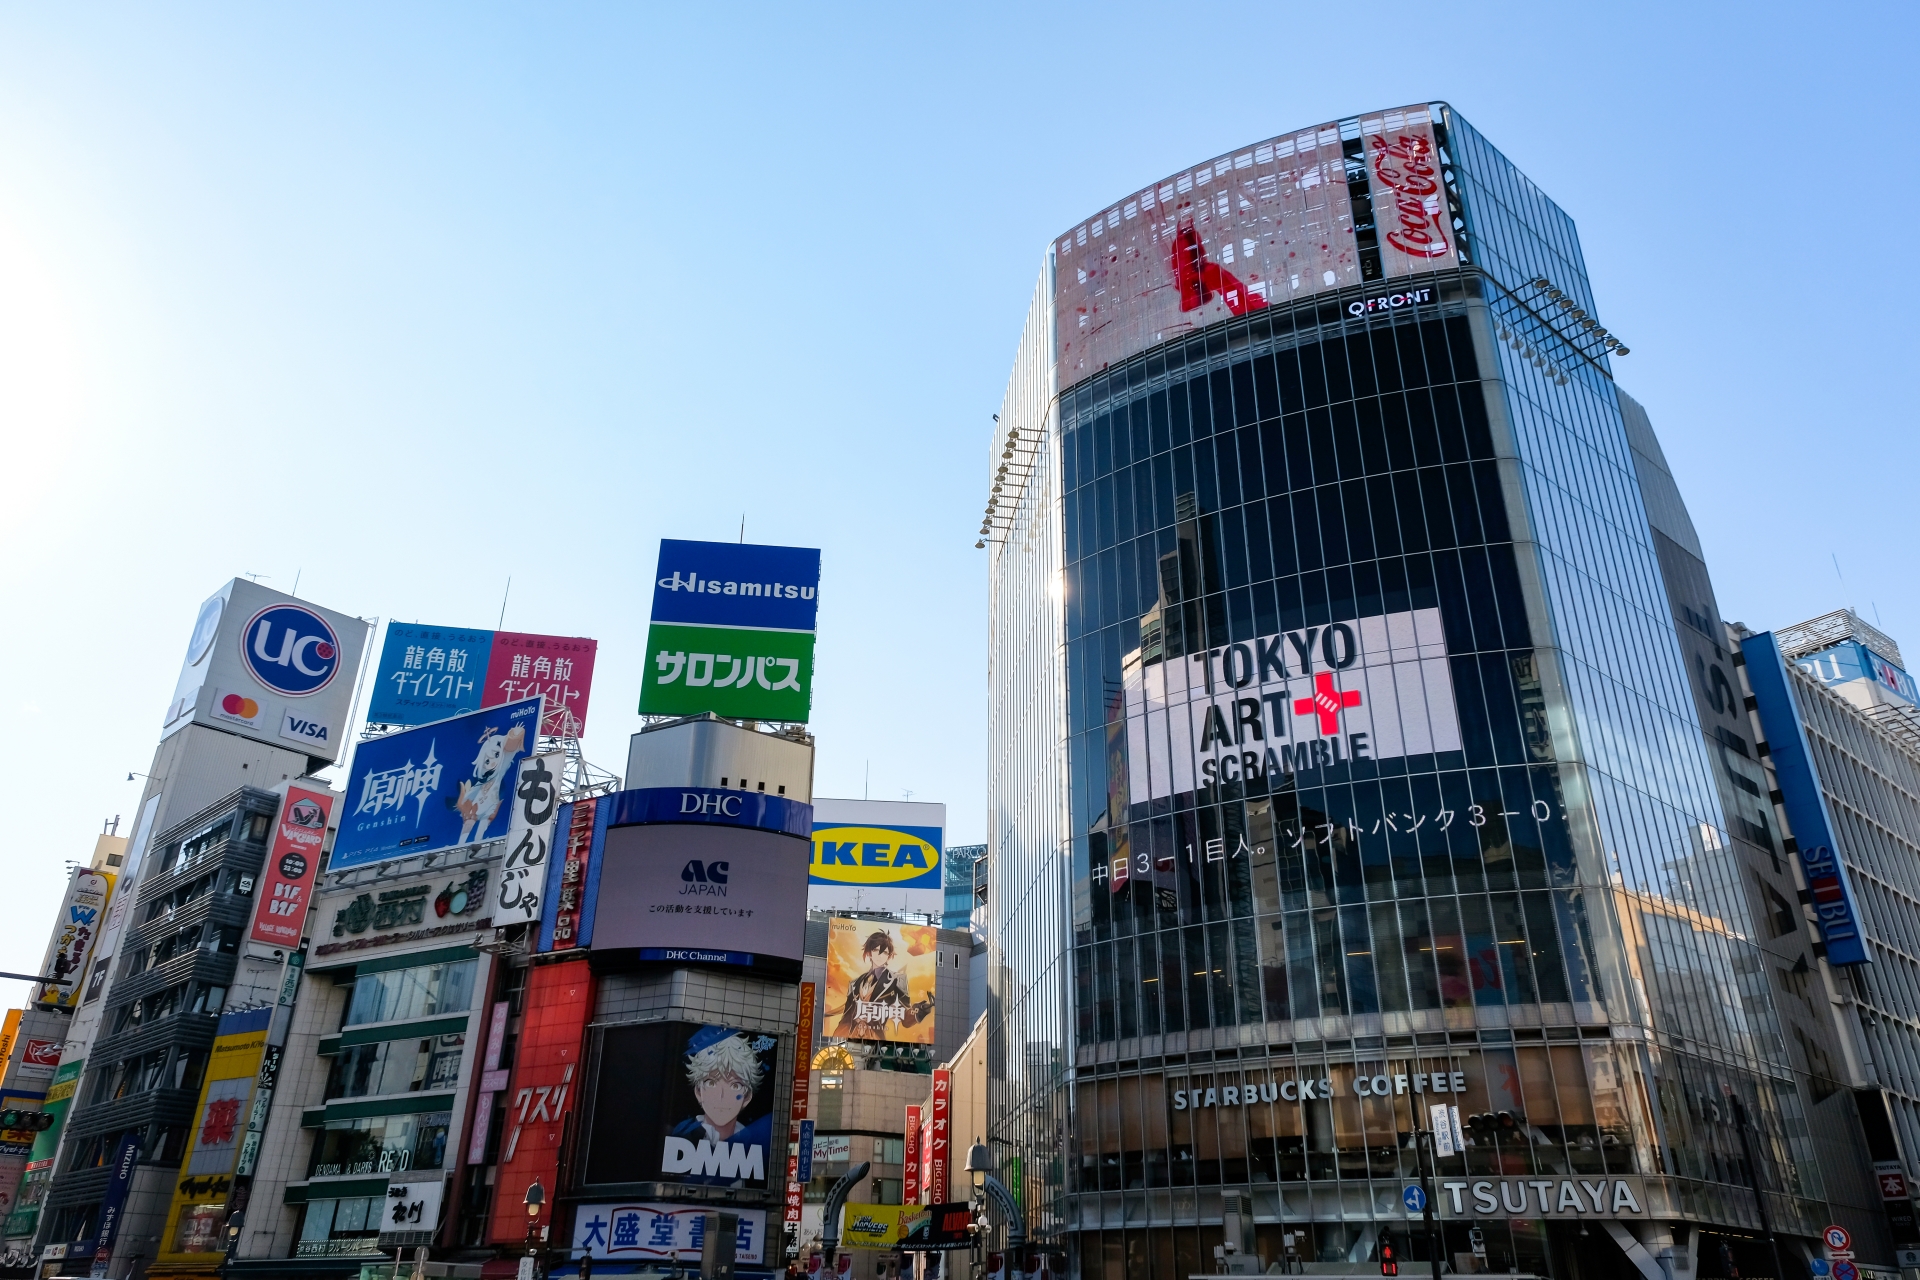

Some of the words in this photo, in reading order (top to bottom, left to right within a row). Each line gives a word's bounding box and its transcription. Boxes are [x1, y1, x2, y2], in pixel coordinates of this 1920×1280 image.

[1385, 133, 1449, 258] Coca-Cola
[1348, 287, 1431, 318] QFRONT
[658, 571, 815, 600] Hisamitsu
[254, 619, 332, 677] UC
[403, 645, 469, 673] 龍角散
[1193, 621, 1357, 695] TOKYO
[510, 654, 574, 682] 龍角散
[655, 650, 801, 693] サロンパス
[390, 671, 474, 699] ダイレクト
[219, 712, 254, 727] mastercard
[510, 706, 537, 720] miHoYo
[1200, 689, 1293, 752] ART
[287, 715, 329, 742] VISA
[1201, 731, 1371, 789] SCRAMBLE
[352, 738, 444, 829] 原神
[680, 792, 743, 817] DHC
[357, 814, 406, 832] Genshin
[500, 757, 556, 918] もんじゃ
[952, 846, 987, 859] PARCO
[553, 803, 590, 941] 三千里薬品
[680, 859, 730, 884] AC
[273, 882, 301, 899] B1F
[678, 883, 728, 898] JAPAN
[1803, 845, 1855, 941] SEIBU
[269, 899, 299, 917] B2F
[648, 903, 755, 918] この活動を支援しています
[831, 923, 857, 932] miHoYo
[665, 949, 688, 961] DHC
[689, 949, 728, 963] Channel
[852, 993, 906, 1036] 原神
[796, 985, 813, 1073] クスリのことなら
[514, 1083, 569, 1124] クスリ
[1173, 1078, 1335, 1111] STARBUCKS
[1353, 1071, 1468, 1097] COFFEE
[908, 1116, 916, 1132] BIG
[932, 1079, 948, 1151] カラオケ
[813, 1149, 828, 1159] My
[828, 1144, 849, 1155] Time
[907, 1132, 916, 1154] ECHO
[119, 1144, 136, 1180] MIZUHO
[661, 1135, 765, 1181] DMM
[933, 1159, 943, 1178] BIG
[933, 1179, 943, 1205] ECHO
[1443, 1179, 1643, 1214] TSUTAYA
[1882, 1177, 1903, 1195] 本
[99, 1206, 116, 1246] みずほ銀行
